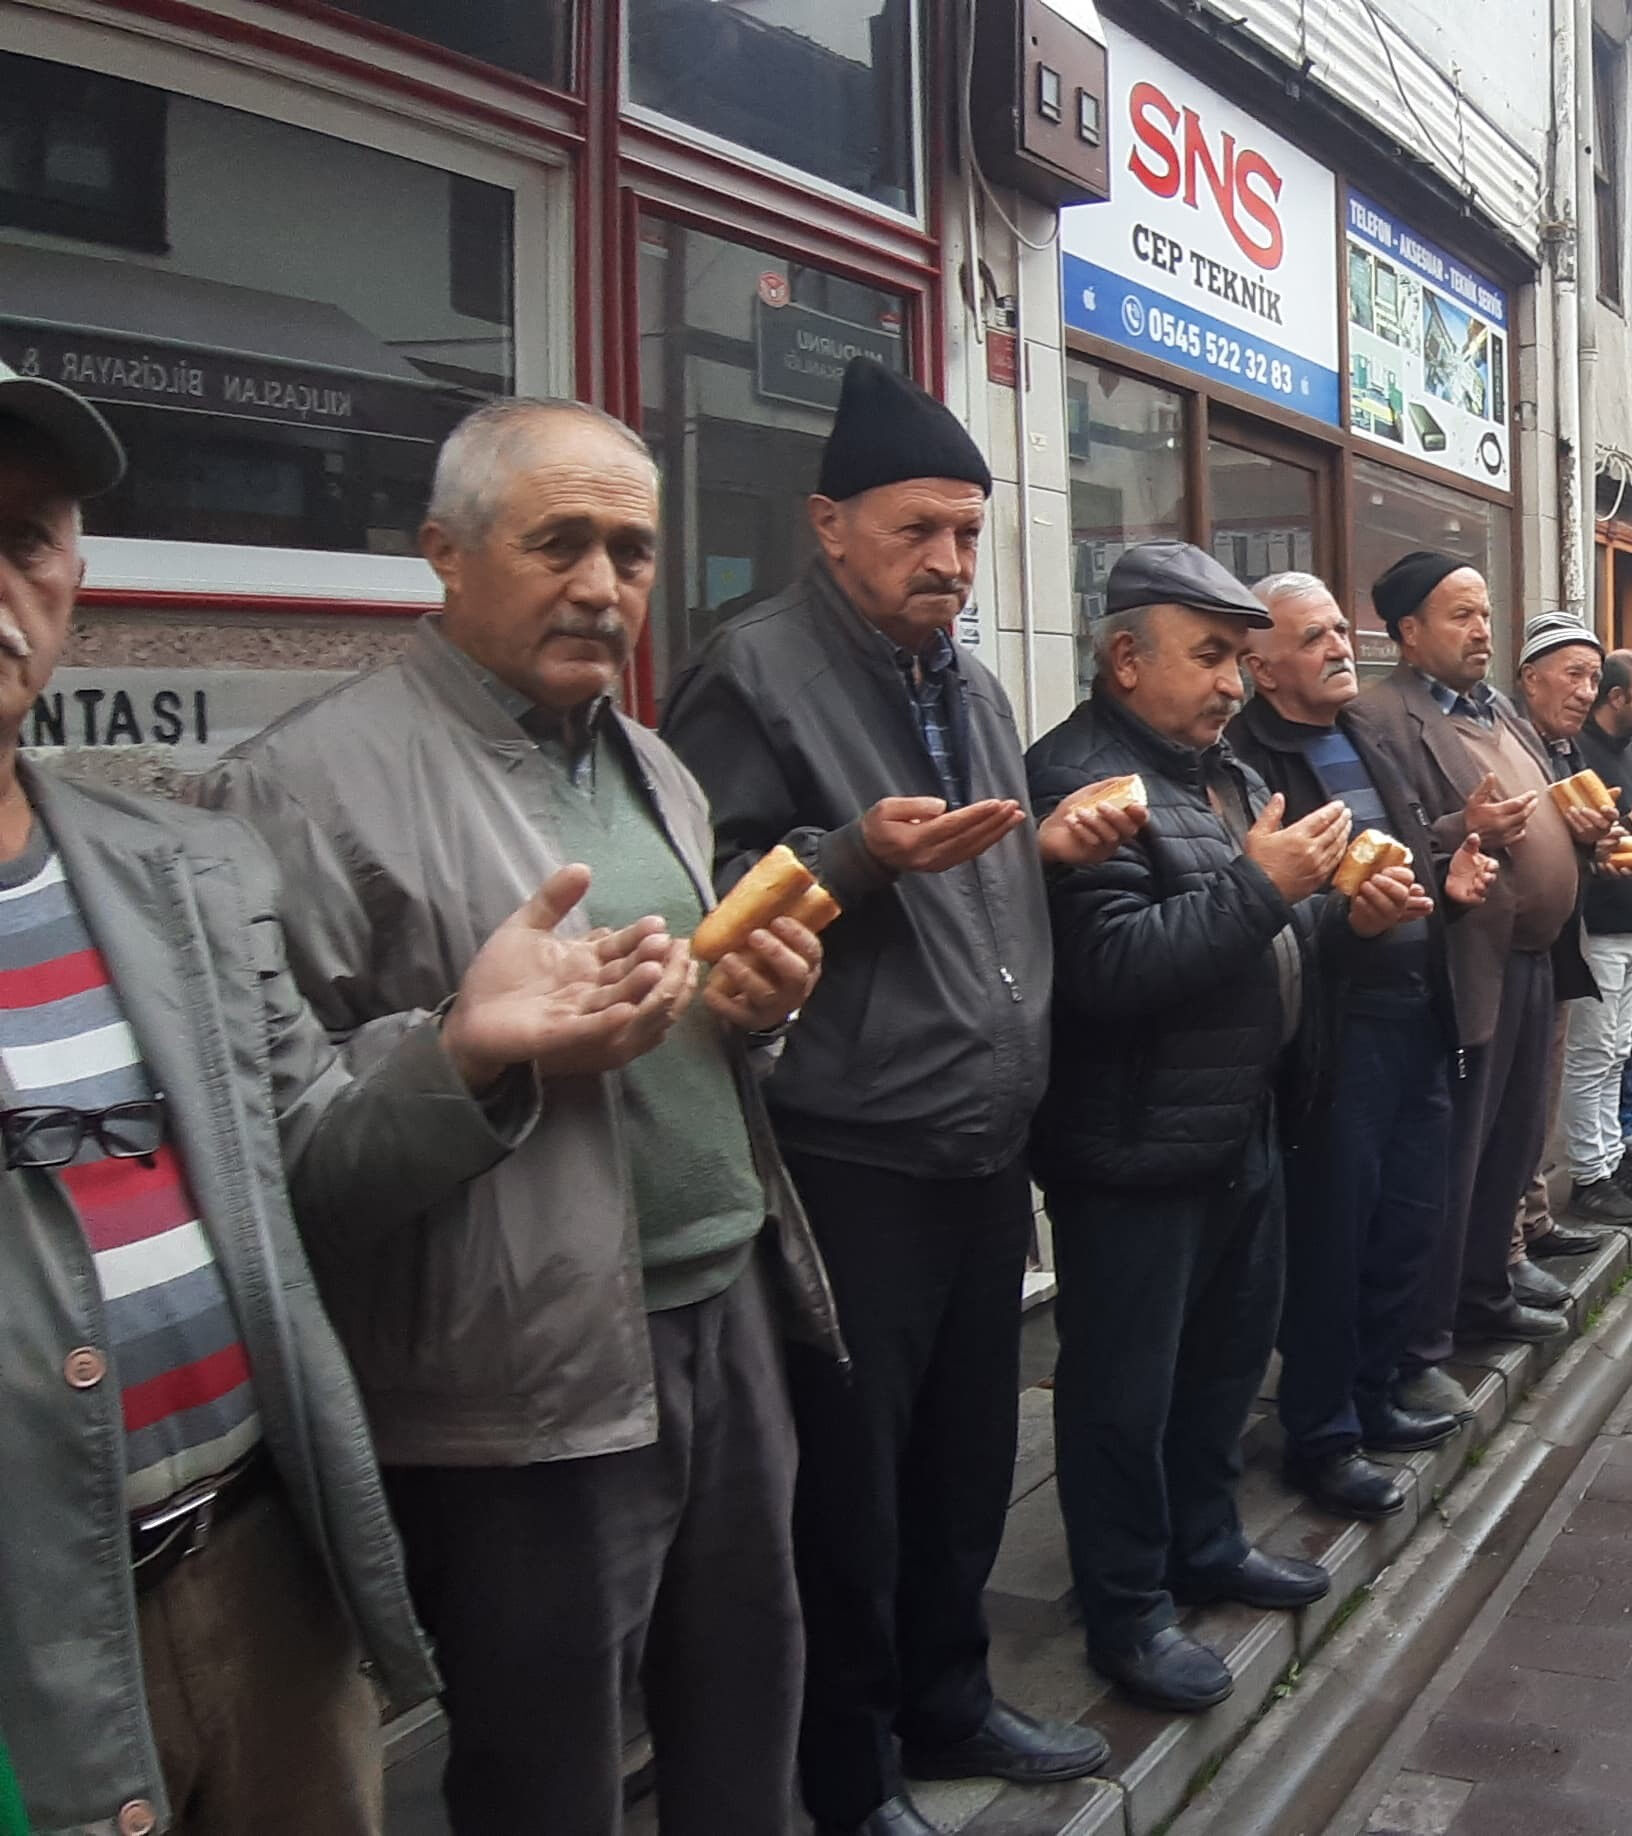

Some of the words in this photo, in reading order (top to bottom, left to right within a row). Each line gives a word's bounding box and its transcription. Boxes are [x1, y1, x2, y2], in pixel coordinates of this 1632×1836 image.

[1128, 82, 1284, 271] SNS
[1349, 198, 1392, 248] TELEFON
[1132, 223, 1184, 275] CEP
[1190, 249, 1283, 326] TEKNİK
[1148, 307, 1200, 358] 0545
[1206, 331, 1241, 374] 522
[1245, 349, 1270, 383] 32
[1270, 355, 1293, 394] 83
